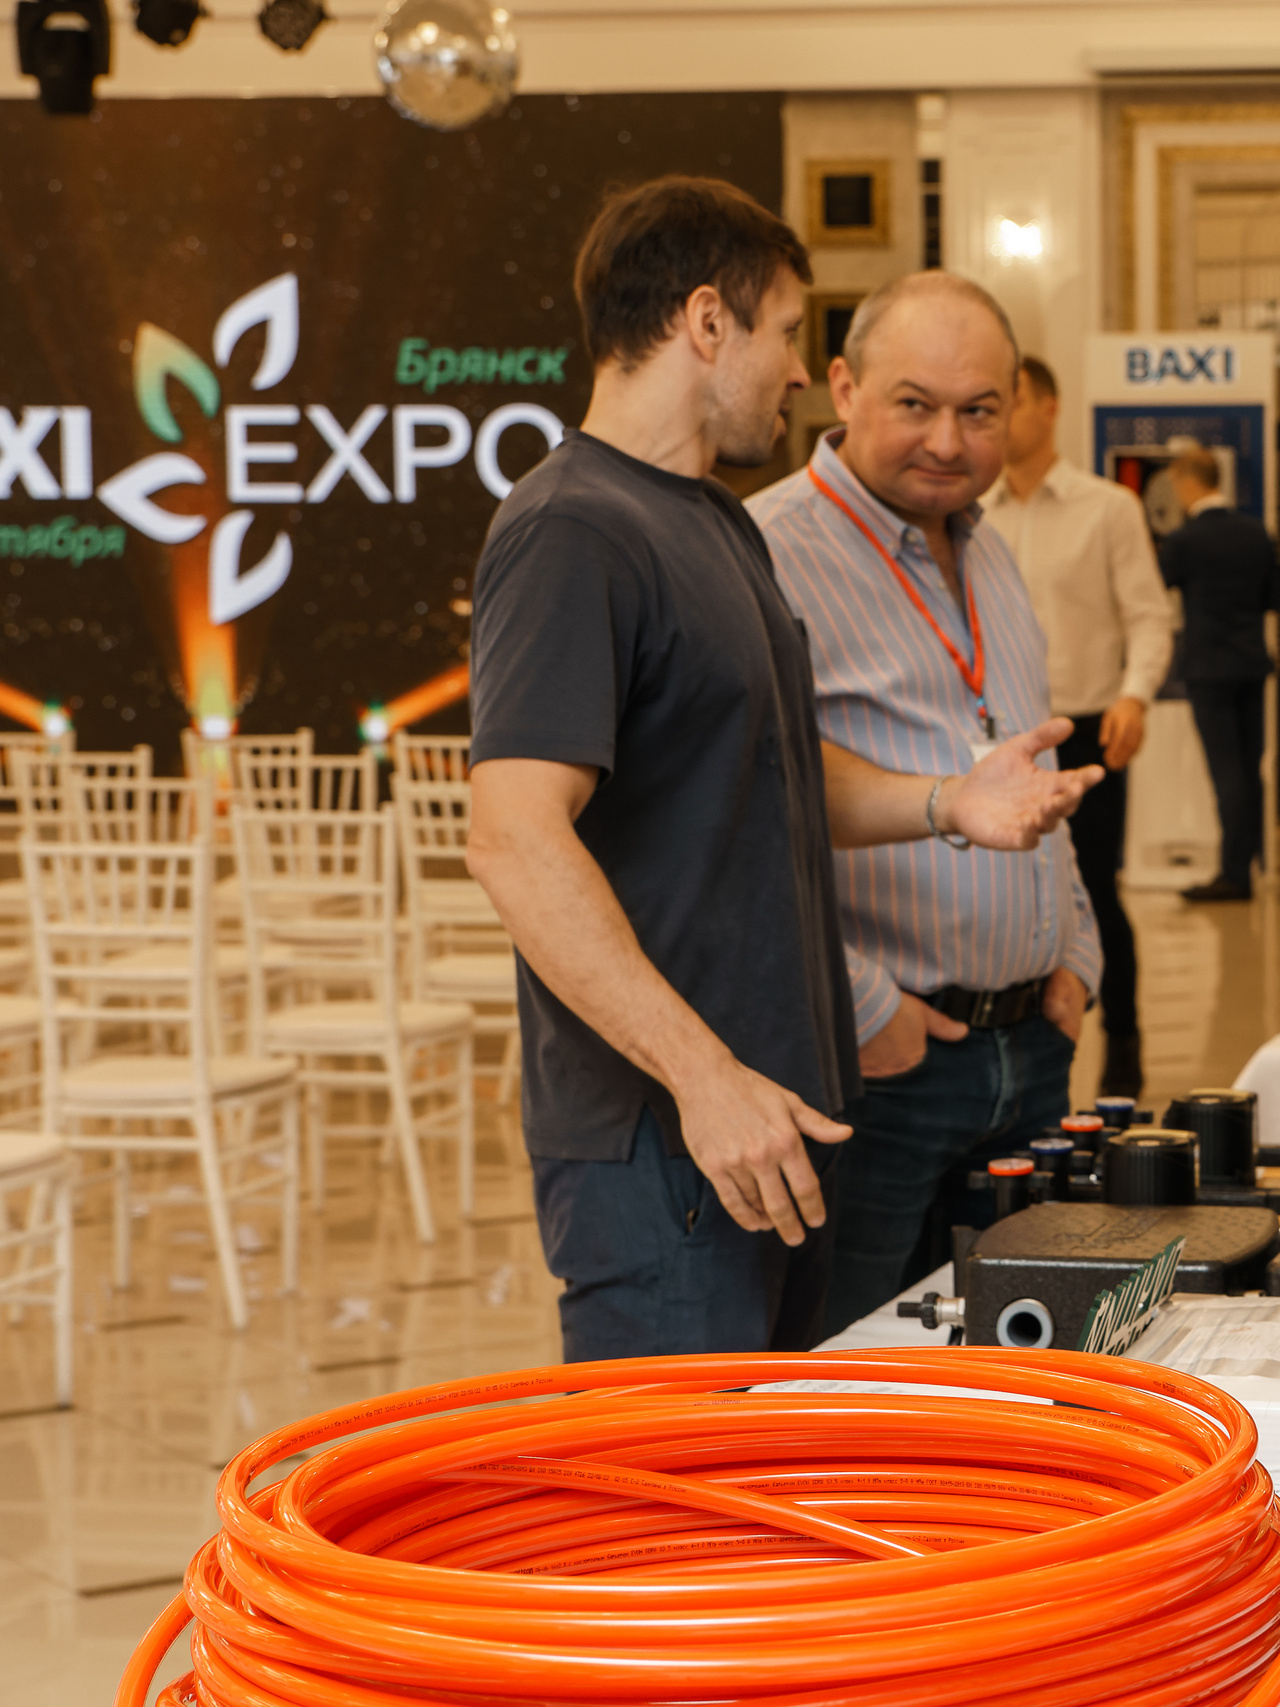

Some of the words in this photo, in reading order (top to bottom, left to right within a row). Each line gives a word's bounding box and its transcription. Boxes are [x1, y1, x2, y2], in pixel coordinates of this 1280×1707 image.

[395, 337, 568, 394] Брянск
[1126, 346, 1235, 382] BAXI
[224, 402, 564, 503] EXPO
